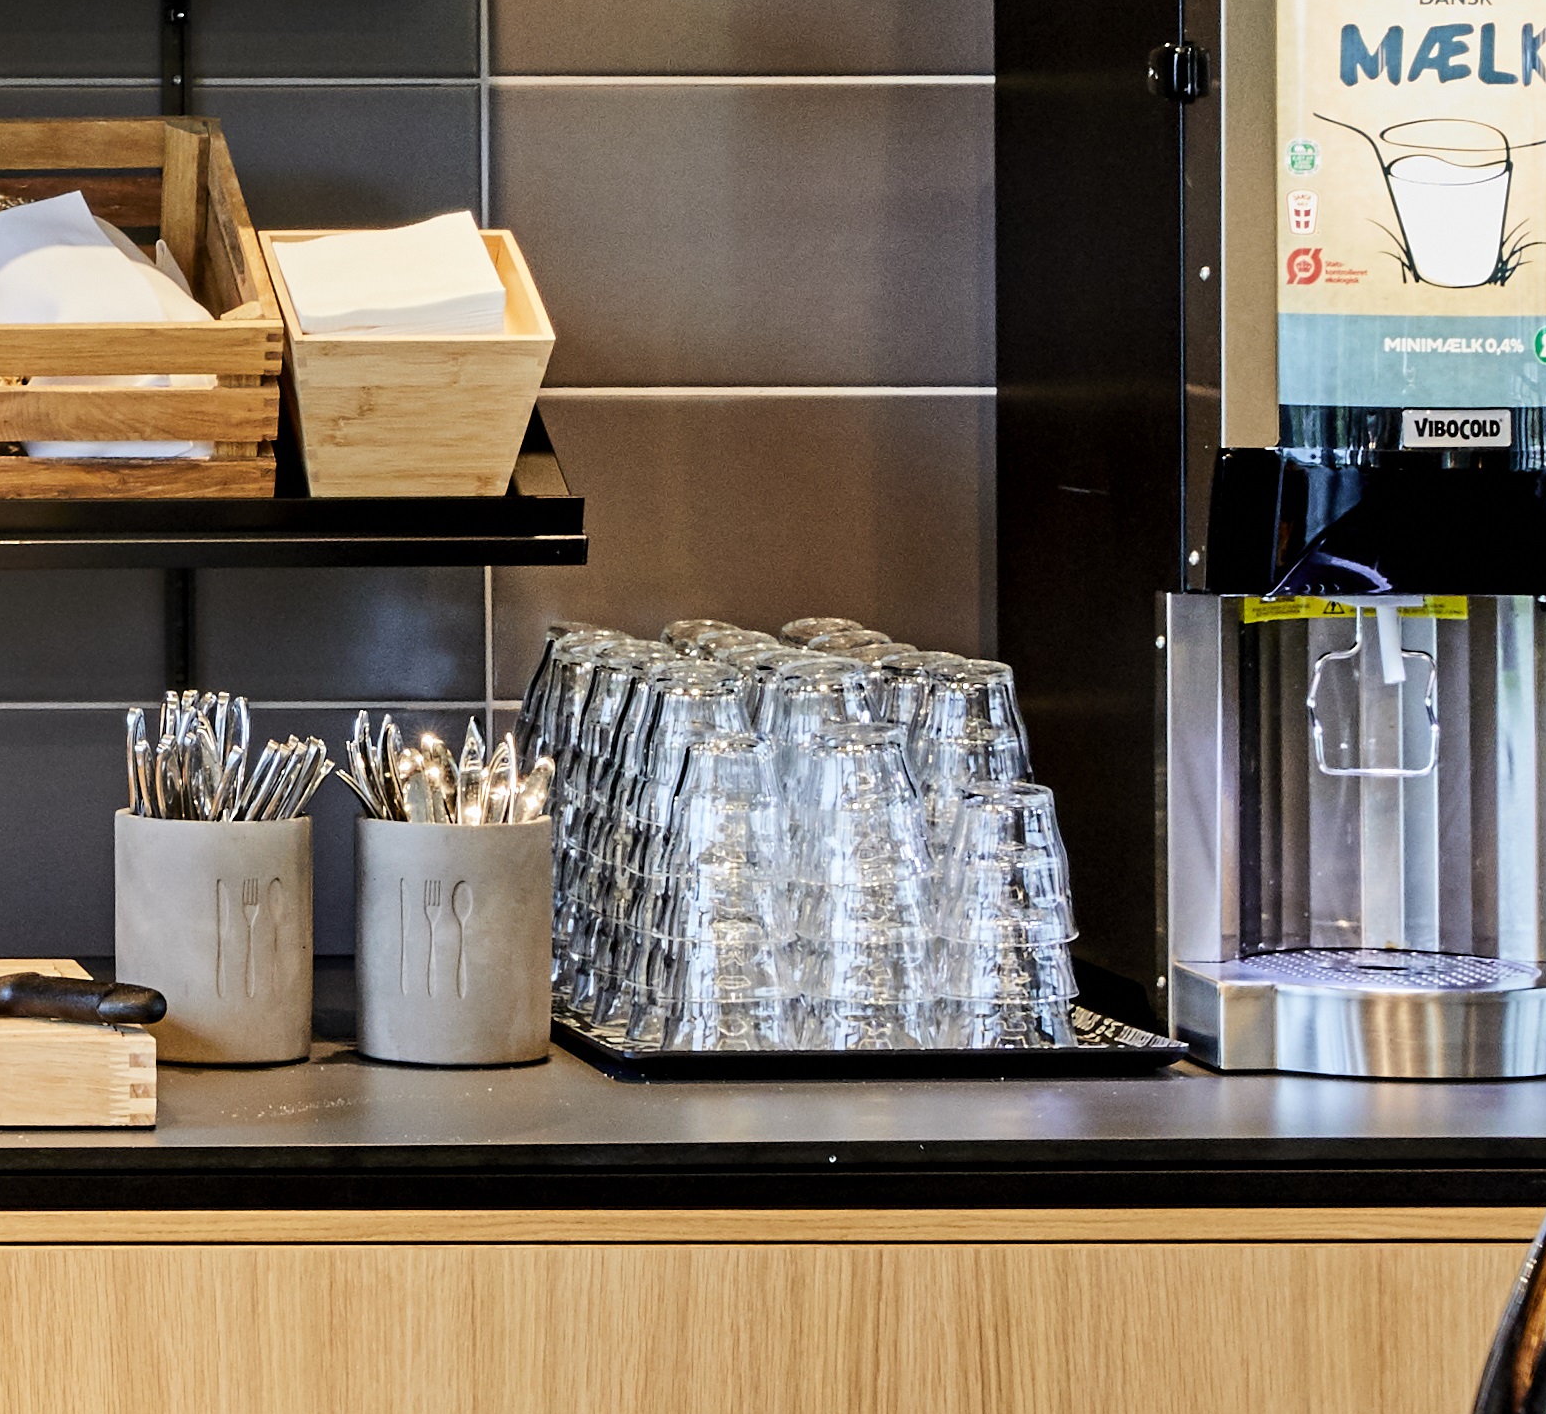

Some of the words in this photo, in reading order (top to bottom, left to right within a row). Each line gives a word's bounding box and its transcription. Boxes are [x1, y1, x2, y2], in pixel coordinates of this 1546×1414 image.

[1384, 336, 1483, 354] MINIMÆLK
[1485, 336, 1524, 355] 0,4%
[1414, 418, 1502, 440] VIBOCOLD
